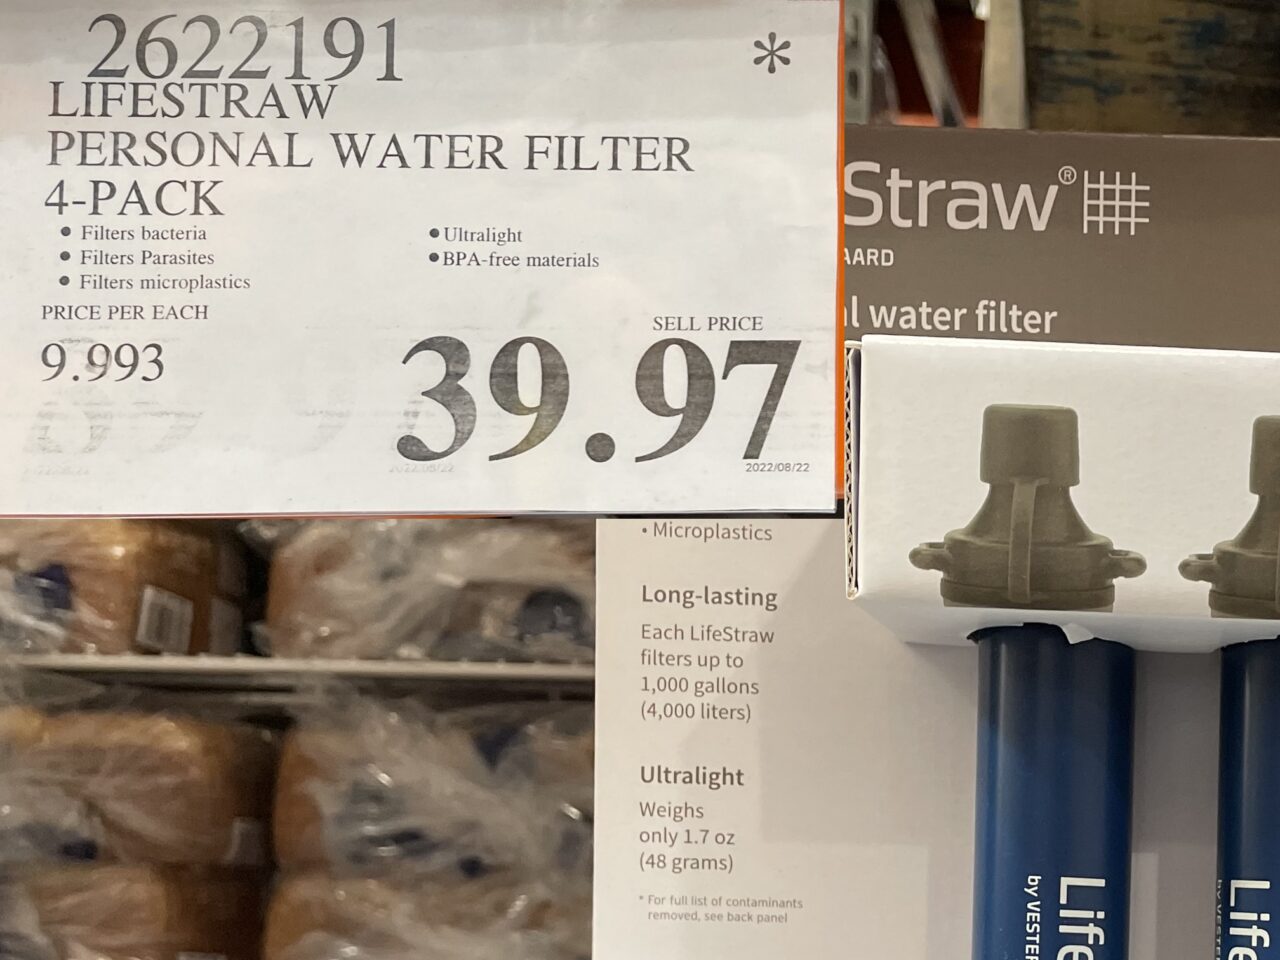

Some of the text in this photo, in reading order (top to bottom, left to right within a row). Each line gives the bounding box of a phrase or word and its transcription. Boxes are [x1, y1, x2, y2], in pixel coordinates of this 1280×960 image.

[87, 13, 403, 81] 2622191
[48, 81, 338, 120] LIFESTRAW
[47, 130, 694, 172] PERSONAL WATER FILTER
[43, 179, 224, 217] 4-PACK
[81, 224, 207, 242] Filters bacteria
[444, 226, 523, 246] Ultralight
[80, 249, 215, 267] Filters Parasites
[443, 251, 600, 270] BPA-free materials
[79, 273, 251, 294] Filters microplastics
[41, 305, 210, 321] PRICE PER EACH
[869, 301, 967, 331] water
[975, 300, 1058, 334] filter
[653, 316, 764, 333] SELL PRICE
[41, 341, 165, 384] 9.993
[396, 334, 802, 465] 39.97
[745, 463, 811, 474] 2022/08/22
[653, 522, 773, 542] Microplastics
[641, 585, 778, 611] Long-lasting
[641, 624, 775, 644] Each LifeStraw
[641, 649, 744, 672] filters up to
[641, 677, 759, 698] 1,000 gallons
[641, 700, 752, 724] (4,000 liters)
[640, 765, 745, 790] Ultralight
[639, 801, 704, 822] Weighs
[639, 828, 736, 847] only 1.7 oz
[640, 854, 734, 874] (48 grams)
[1024, 875, 1042, 897] by
[647, 894, 804, 909] For full list of contaminants
[647, 909, 788, 925] removed, see back panel
